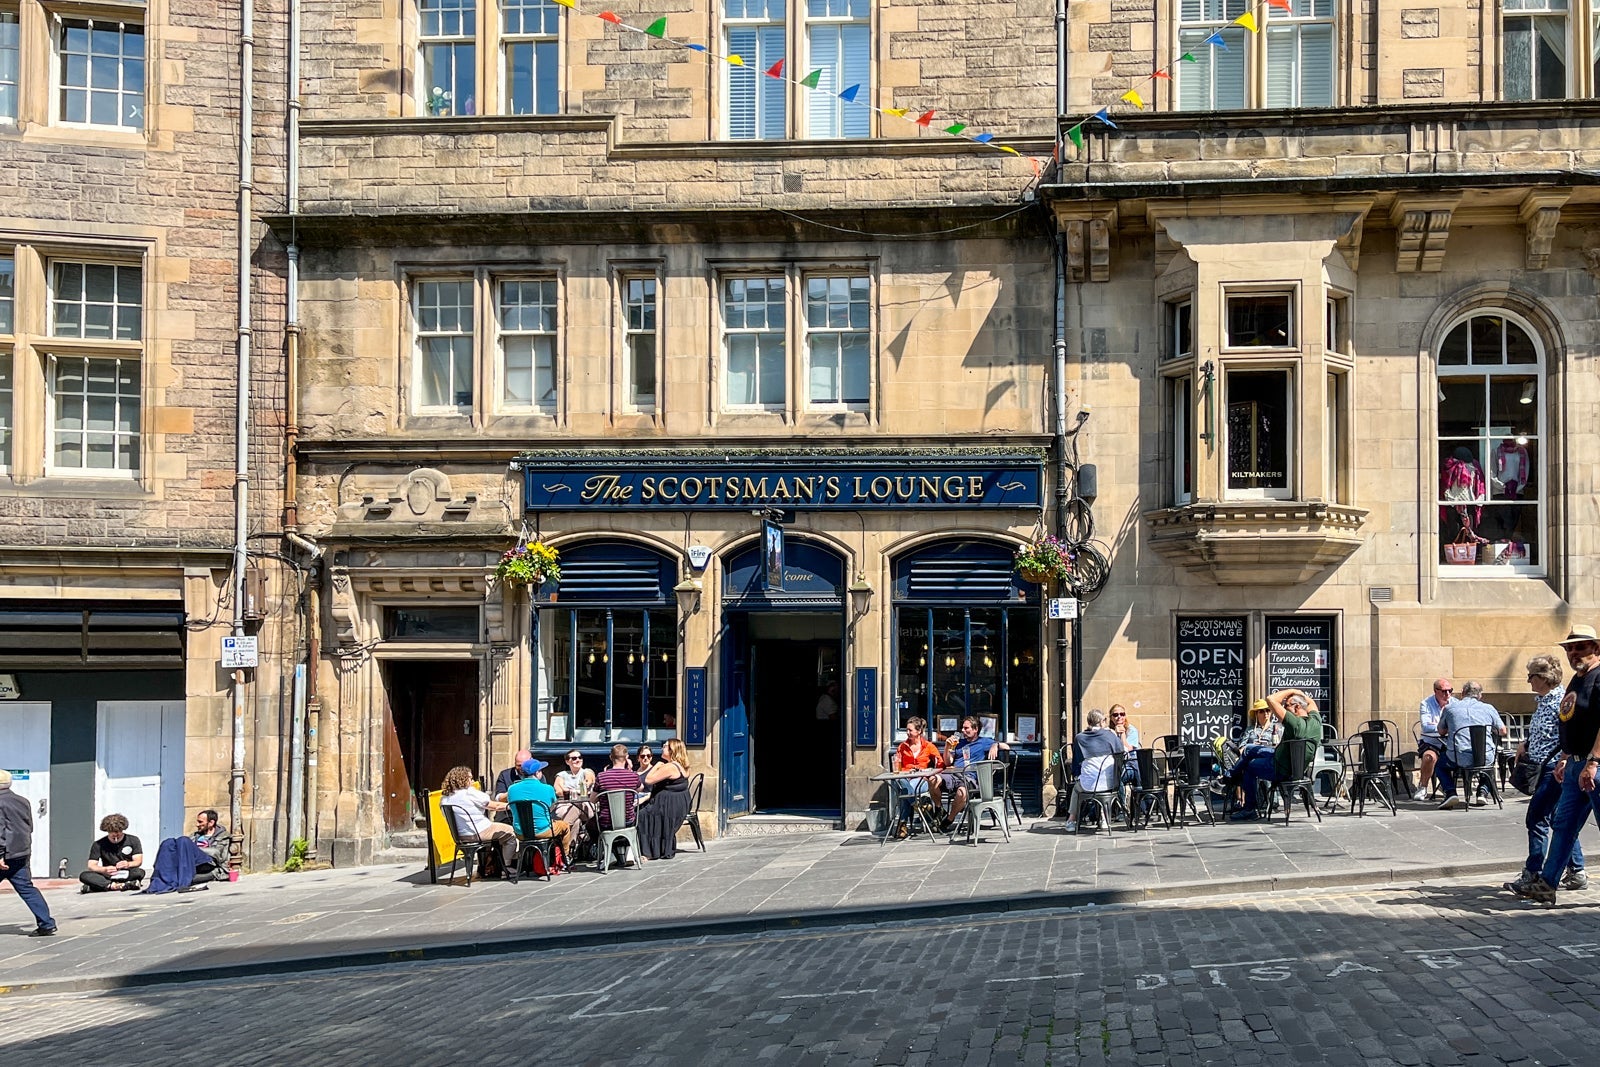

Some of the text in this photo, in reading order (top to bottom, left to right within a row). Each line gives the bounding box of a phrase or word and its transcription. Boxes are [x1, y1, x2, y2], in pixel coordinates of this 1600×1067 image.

[580, 474, 984, 499] The SCOTSMAN'S LOUNGE
[1180, 620, 1242, 629] The SCOTSMAN'S
[1181, 628, 1242, 636] LOUNGE
[1277, 626, 1322, 634] DRAUGHT
[1271, 642, 1310, 650] Heineken
[1180, 649, 1243, 664] OPEN
[1272, 653, 1310, 662] Tennents
[1180, 669, 1205, 678] MON
[1219, 669, 1243, 678] SAT
[1272, 666, 1315, 678] Lagunitas
[1272, 677, 1320, 686] Maltsmiths
[1181, 690, 1243, 699] SUNDAYS
[1197, 710, 1230, 724] Live
[1181, 725, 1242, 741] MUSIC
